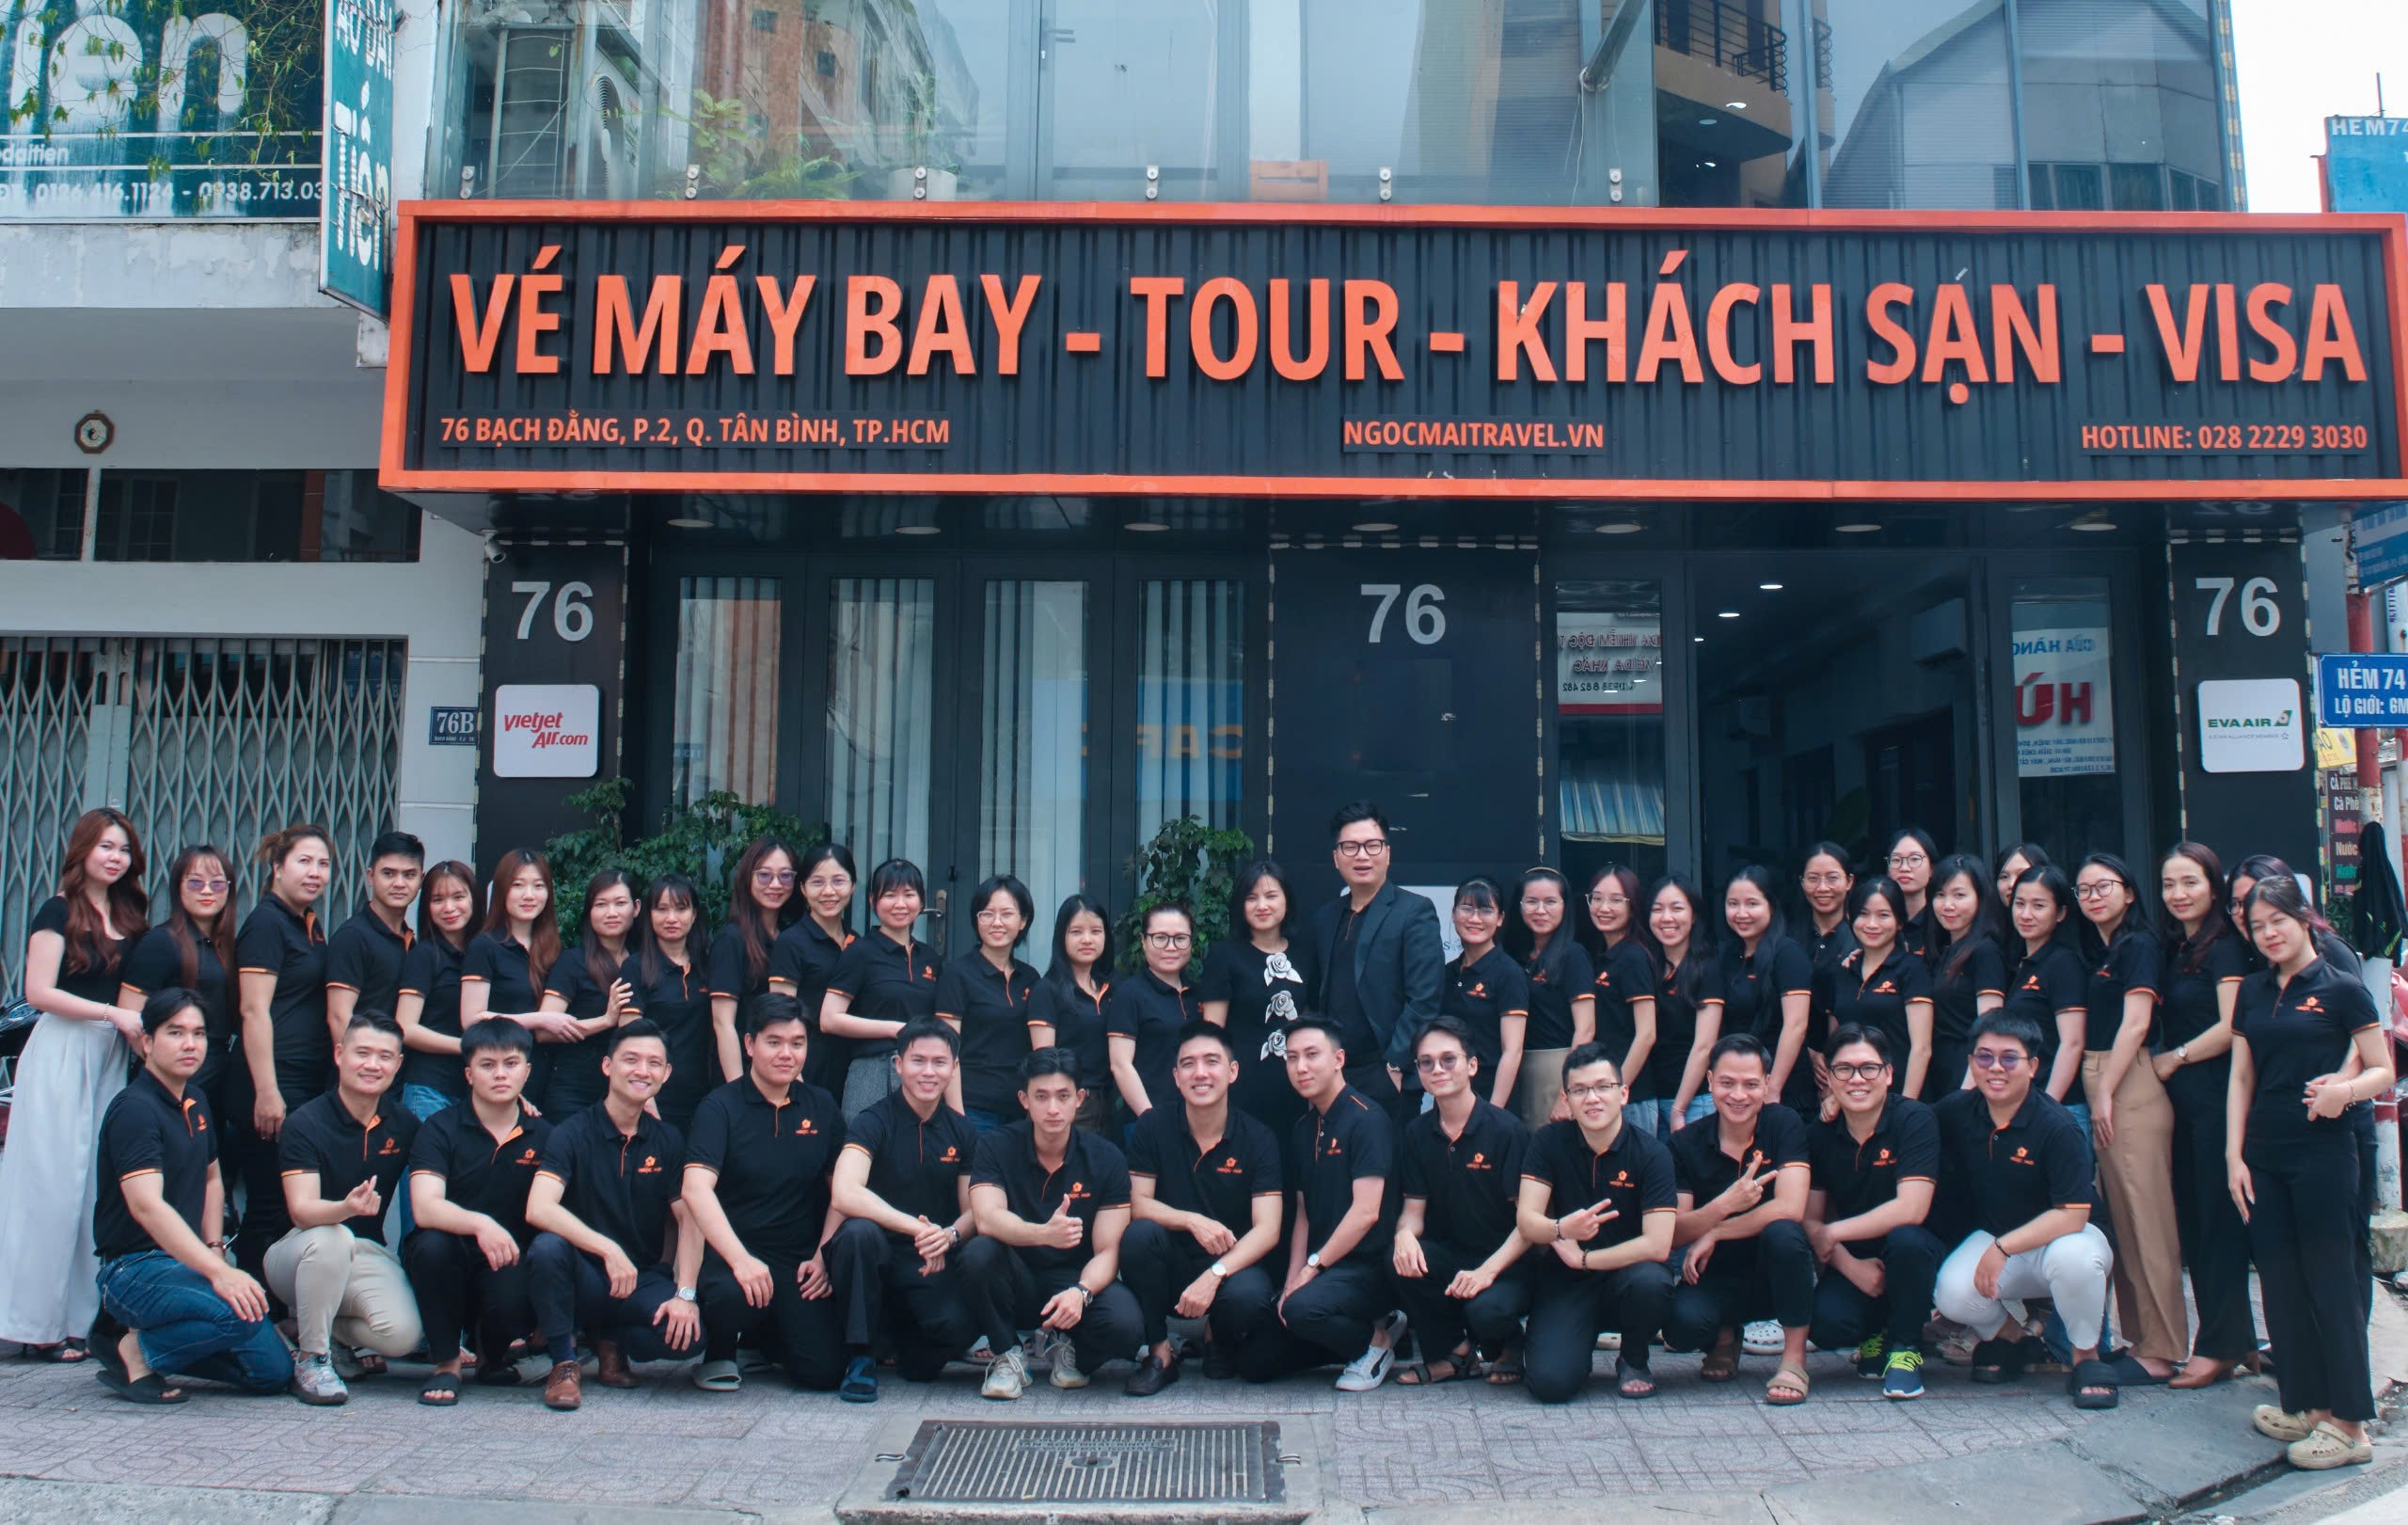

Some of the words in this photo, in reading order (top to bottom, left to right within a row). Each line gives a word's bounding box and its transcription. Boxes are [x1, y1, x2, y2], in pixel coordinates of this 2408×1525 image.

[450, 245, 563, 373] VÉ
[593, 245, 817, 374] MÁY
[846, 275, 1041, 375] BAY
[1130, 277, 1405, 381] TOUR
[1497, 249, 1833, 385] KHÁCH
[1866, 282, 2061, 405] SẠN
[2146, 282, 2368, 383] VISA
[440, 418, 469, 442] 76
[476, 418, 541, 448] BẠCH
[547, 408, 626, 446] ĐẰNG,
[633, 418, 678, 446] P.2,
[686, 418, 712, 447] Q.
[719, 412, 768, 443] TÂN
[775, 412, 847, 447] BÌNH,
[852, 419, 949, 443] TP.HCM
[1344, 421, 1604, 449] NGOCMAITRAVEL.VN
[2082, 425, 2193, 449] HOTLINE:
[2198, 425, 2242, 449] 028
[2248, 425, 2305, 449] 2229
[2311, 425, 2368, 449] 3030
[512, 580, 594, 642] 76
[1360, 583, 1447, 645] 76
[2195, 577, 2281, 637] 76
[2337, 659, 2380, 690] HẺM
[2383, 668, 2406, 690] 74
[436, 711, 475, 734] 76B
[2335, 694, 2352, 718] LỘ
